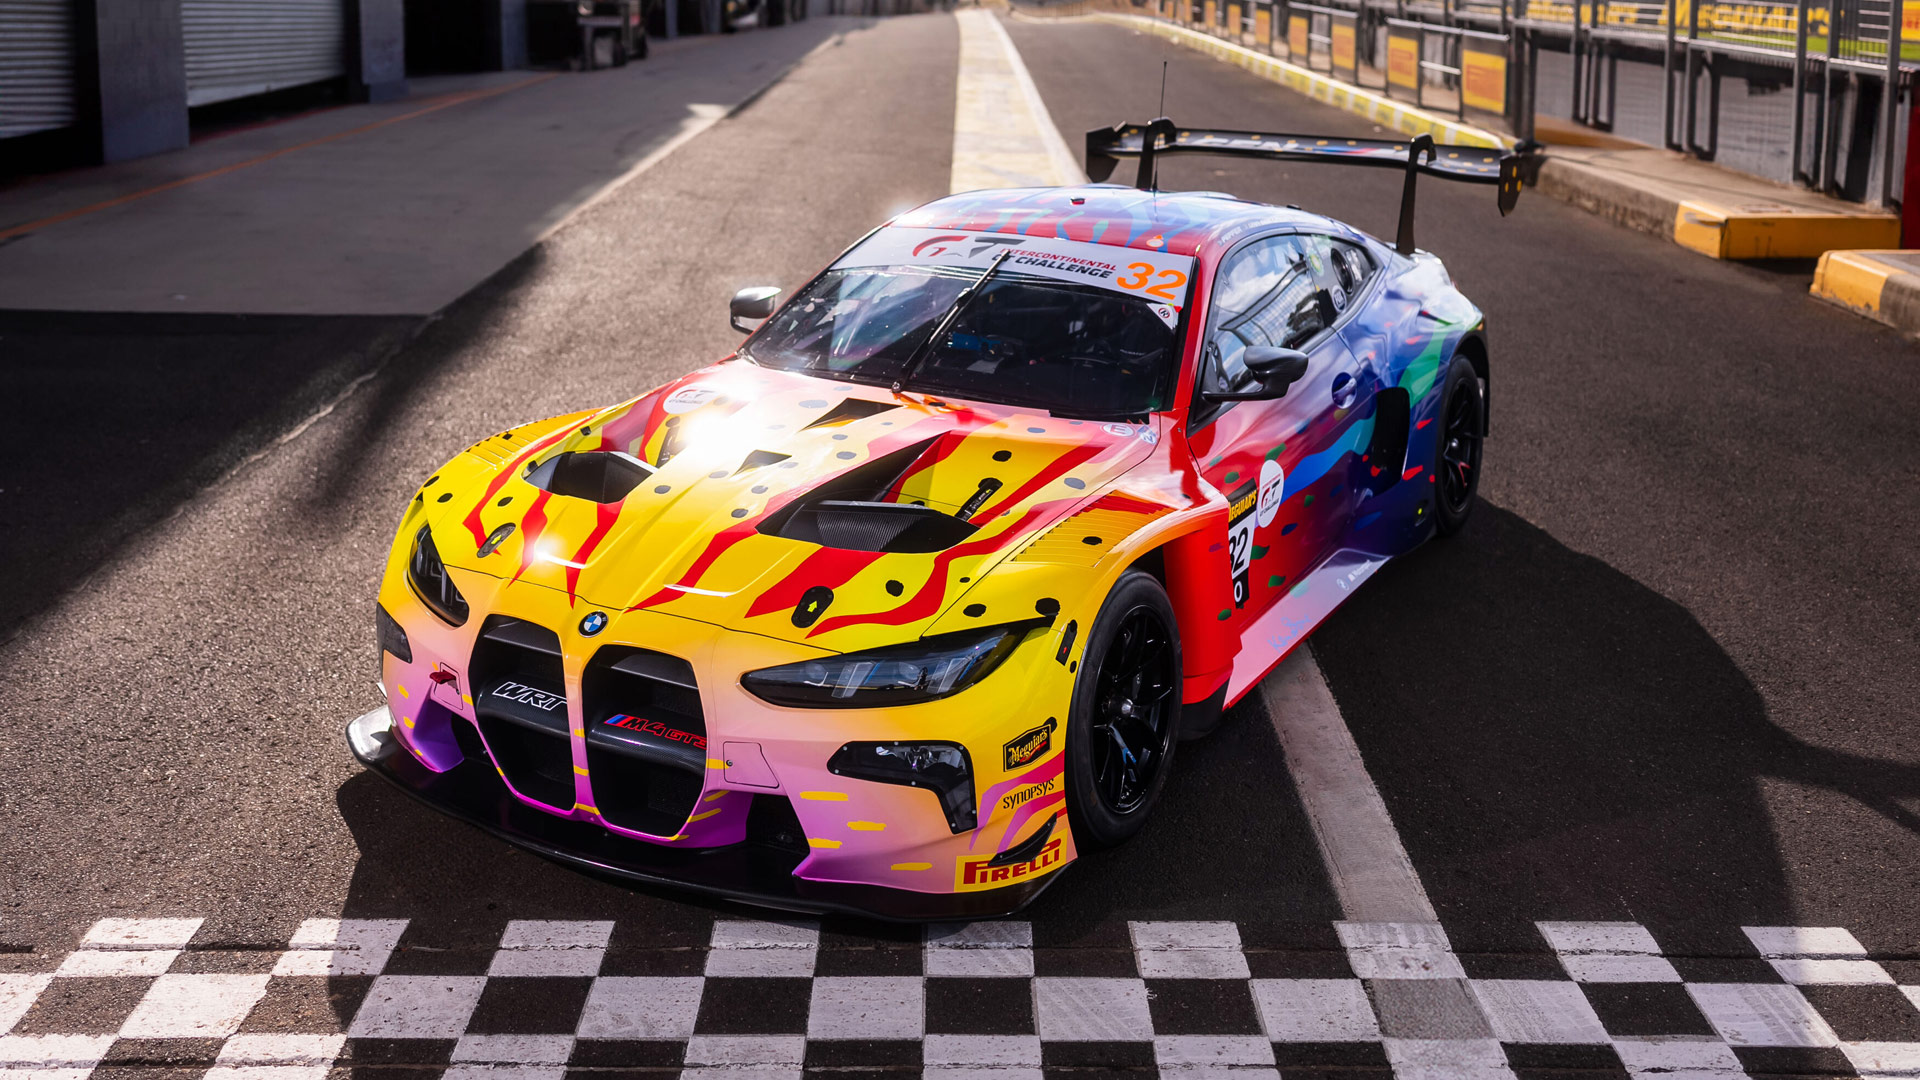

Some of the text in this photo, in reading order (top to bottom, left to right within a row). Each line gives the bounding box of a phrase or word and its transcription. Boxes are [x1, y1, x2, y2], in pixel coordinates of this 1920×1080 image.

[1015, 256, 1114, 279] CHALLENGE
[1116, 261, 1187, 300] 32
[492, 682, 568, 711] WRT
[1008, 730, 1048, 765] Meguiar's
[963, 838, 1062, 885] PIRELLI
